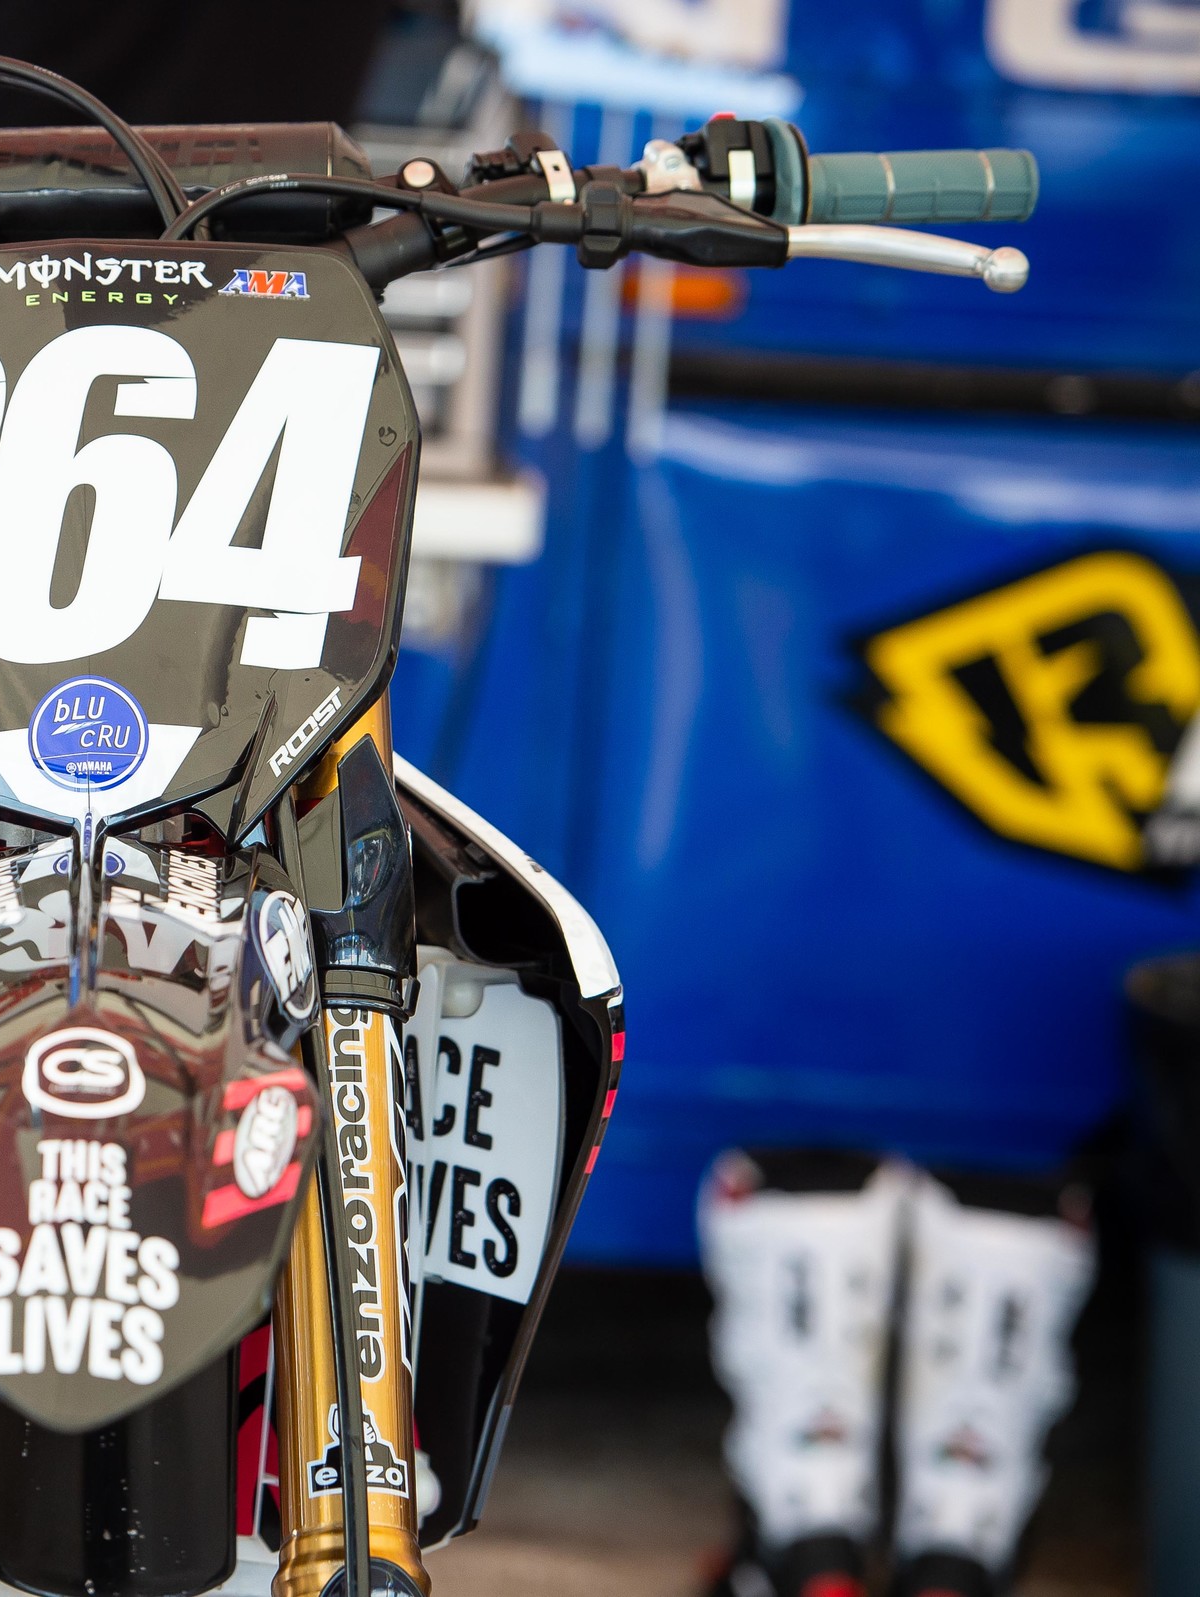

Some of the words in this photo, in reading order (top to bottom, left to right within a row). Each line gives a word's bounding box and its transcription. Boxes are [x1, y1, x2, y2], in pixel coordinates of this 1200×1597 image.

[25, 290, 179, 306] ENERGY
[217, 268, 311, 299] AMA
[266, 685, 342, 778] ROOST
[76, 761, 113, 772] YAMAHA
[37, 1139, 128, 1187] THIS
[28, 1178, 133, 1231] RACE
[314, 1464, 404, 1487] ezo
